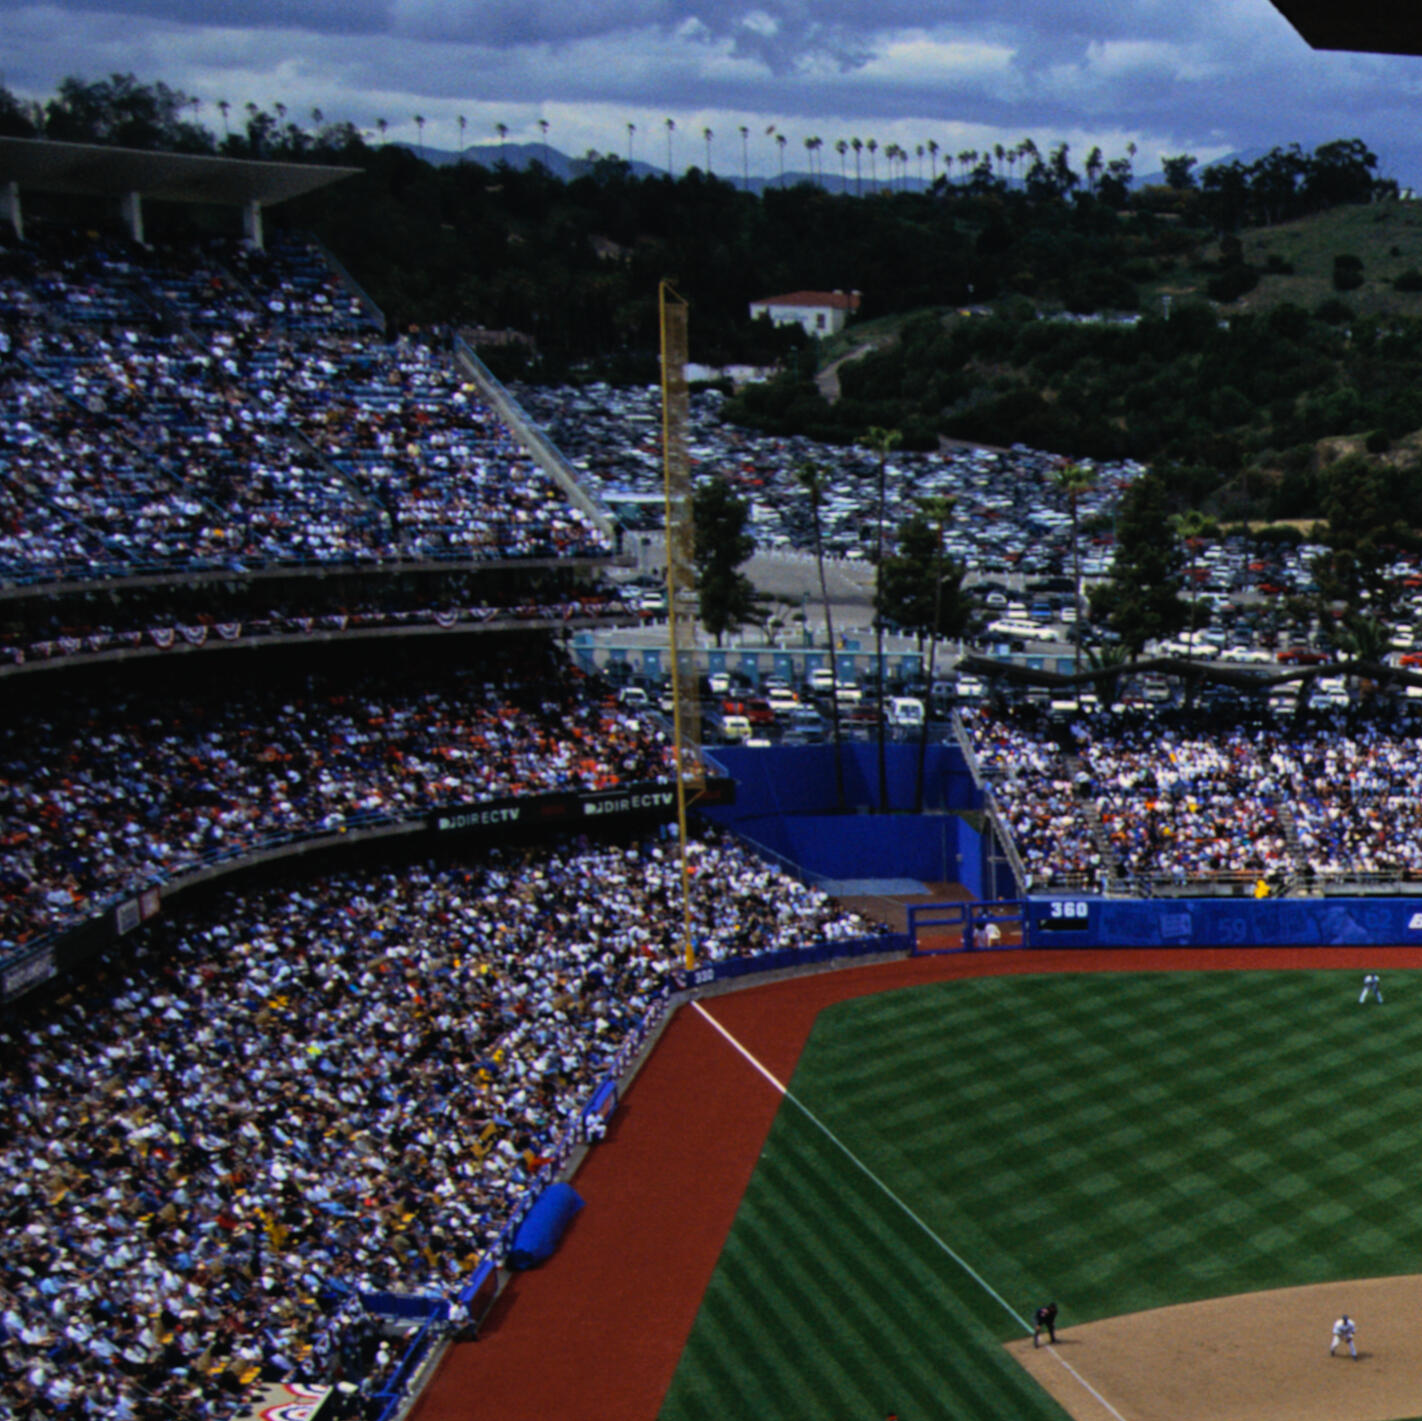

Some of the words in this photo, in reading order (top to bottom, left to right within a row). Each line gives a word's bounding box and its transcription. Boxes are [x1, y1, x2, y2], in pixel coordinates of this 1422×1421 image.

[603, 792, 673, 814] DIRECTV
[455, 807, 520, 829] DIRECTV
[1051, 902, 1088, 917] 360
[1218, 918, 1246, 943] 59
